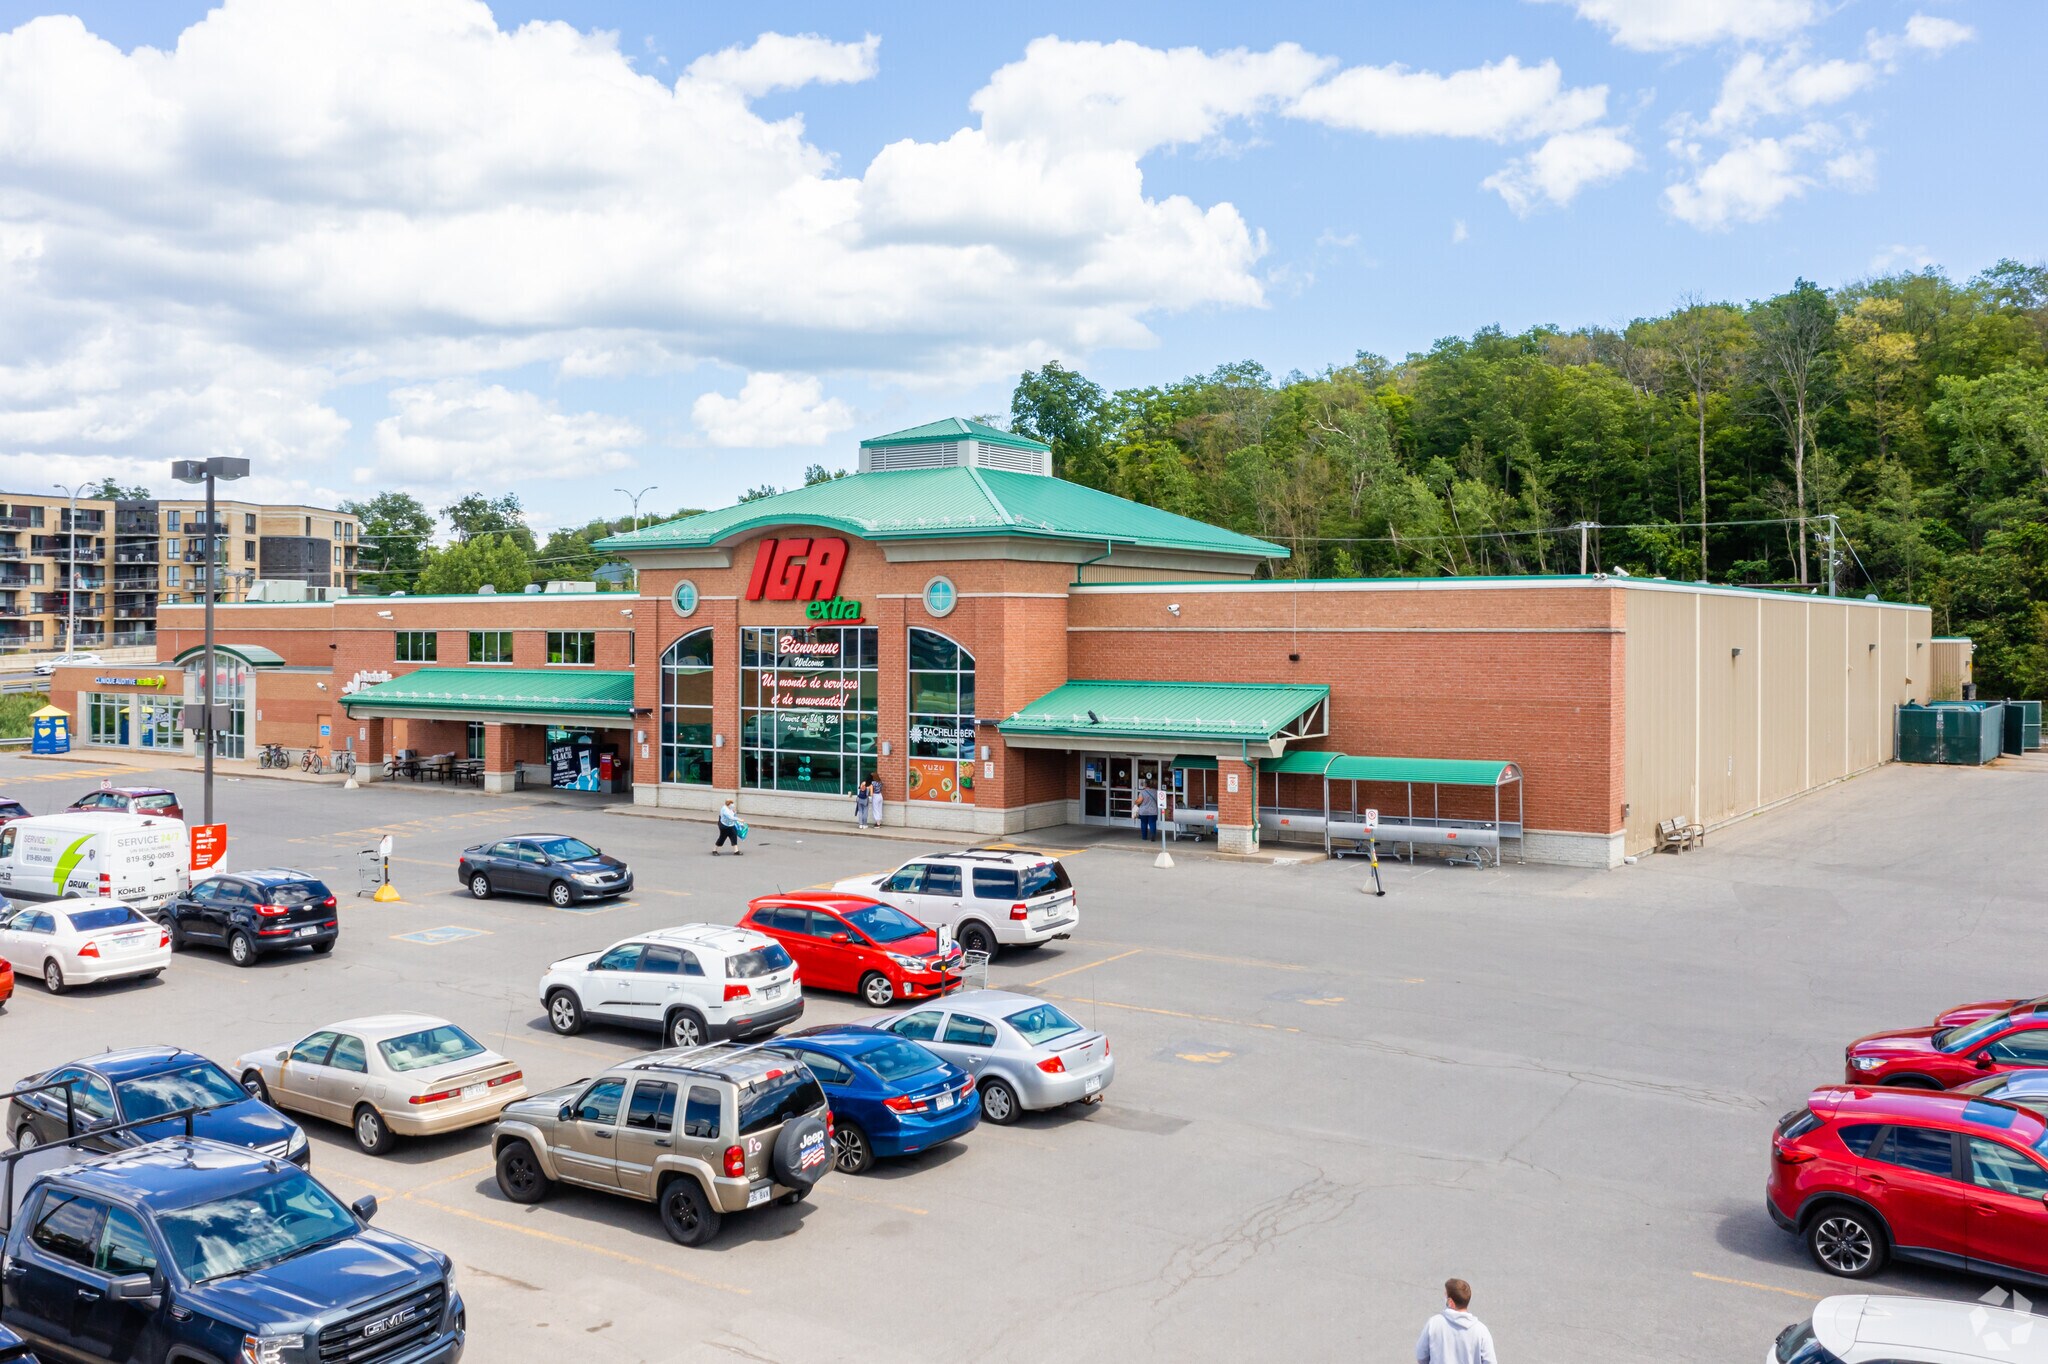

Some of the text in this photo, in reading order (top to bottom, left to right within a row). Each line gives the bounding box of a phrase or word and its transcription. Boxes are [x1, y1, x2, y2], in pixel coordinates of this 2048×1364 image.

[745, 537, 849, 601] IGA
[805, 596, 862, 620] extra
[780, 635, 840, 655] Bienvenue
[794, 657, 825, 667] Welcome
[761, 673, 777, 687] Un
[779, 676, 808, 688] monde
[809, 676, 821, 688] de
[782, 693, 794, 705] de
[780, 713, 800, 723] Ouvert
[826, 714, 839, 724] 22h
[923, 728, 958, 738] RACHELLE
[117, 835, 159, 848] SERVICE
[126, 851, 175, 864] 819-850-0093
[68, 880, 89, 889] DRUM
[117, 886, 146, 896] KOHLER
[153, 892, 177, 901] DRU
[800, 1130, 824, 1149] Jeep
[364, 1306, 416, 1337] GMC
